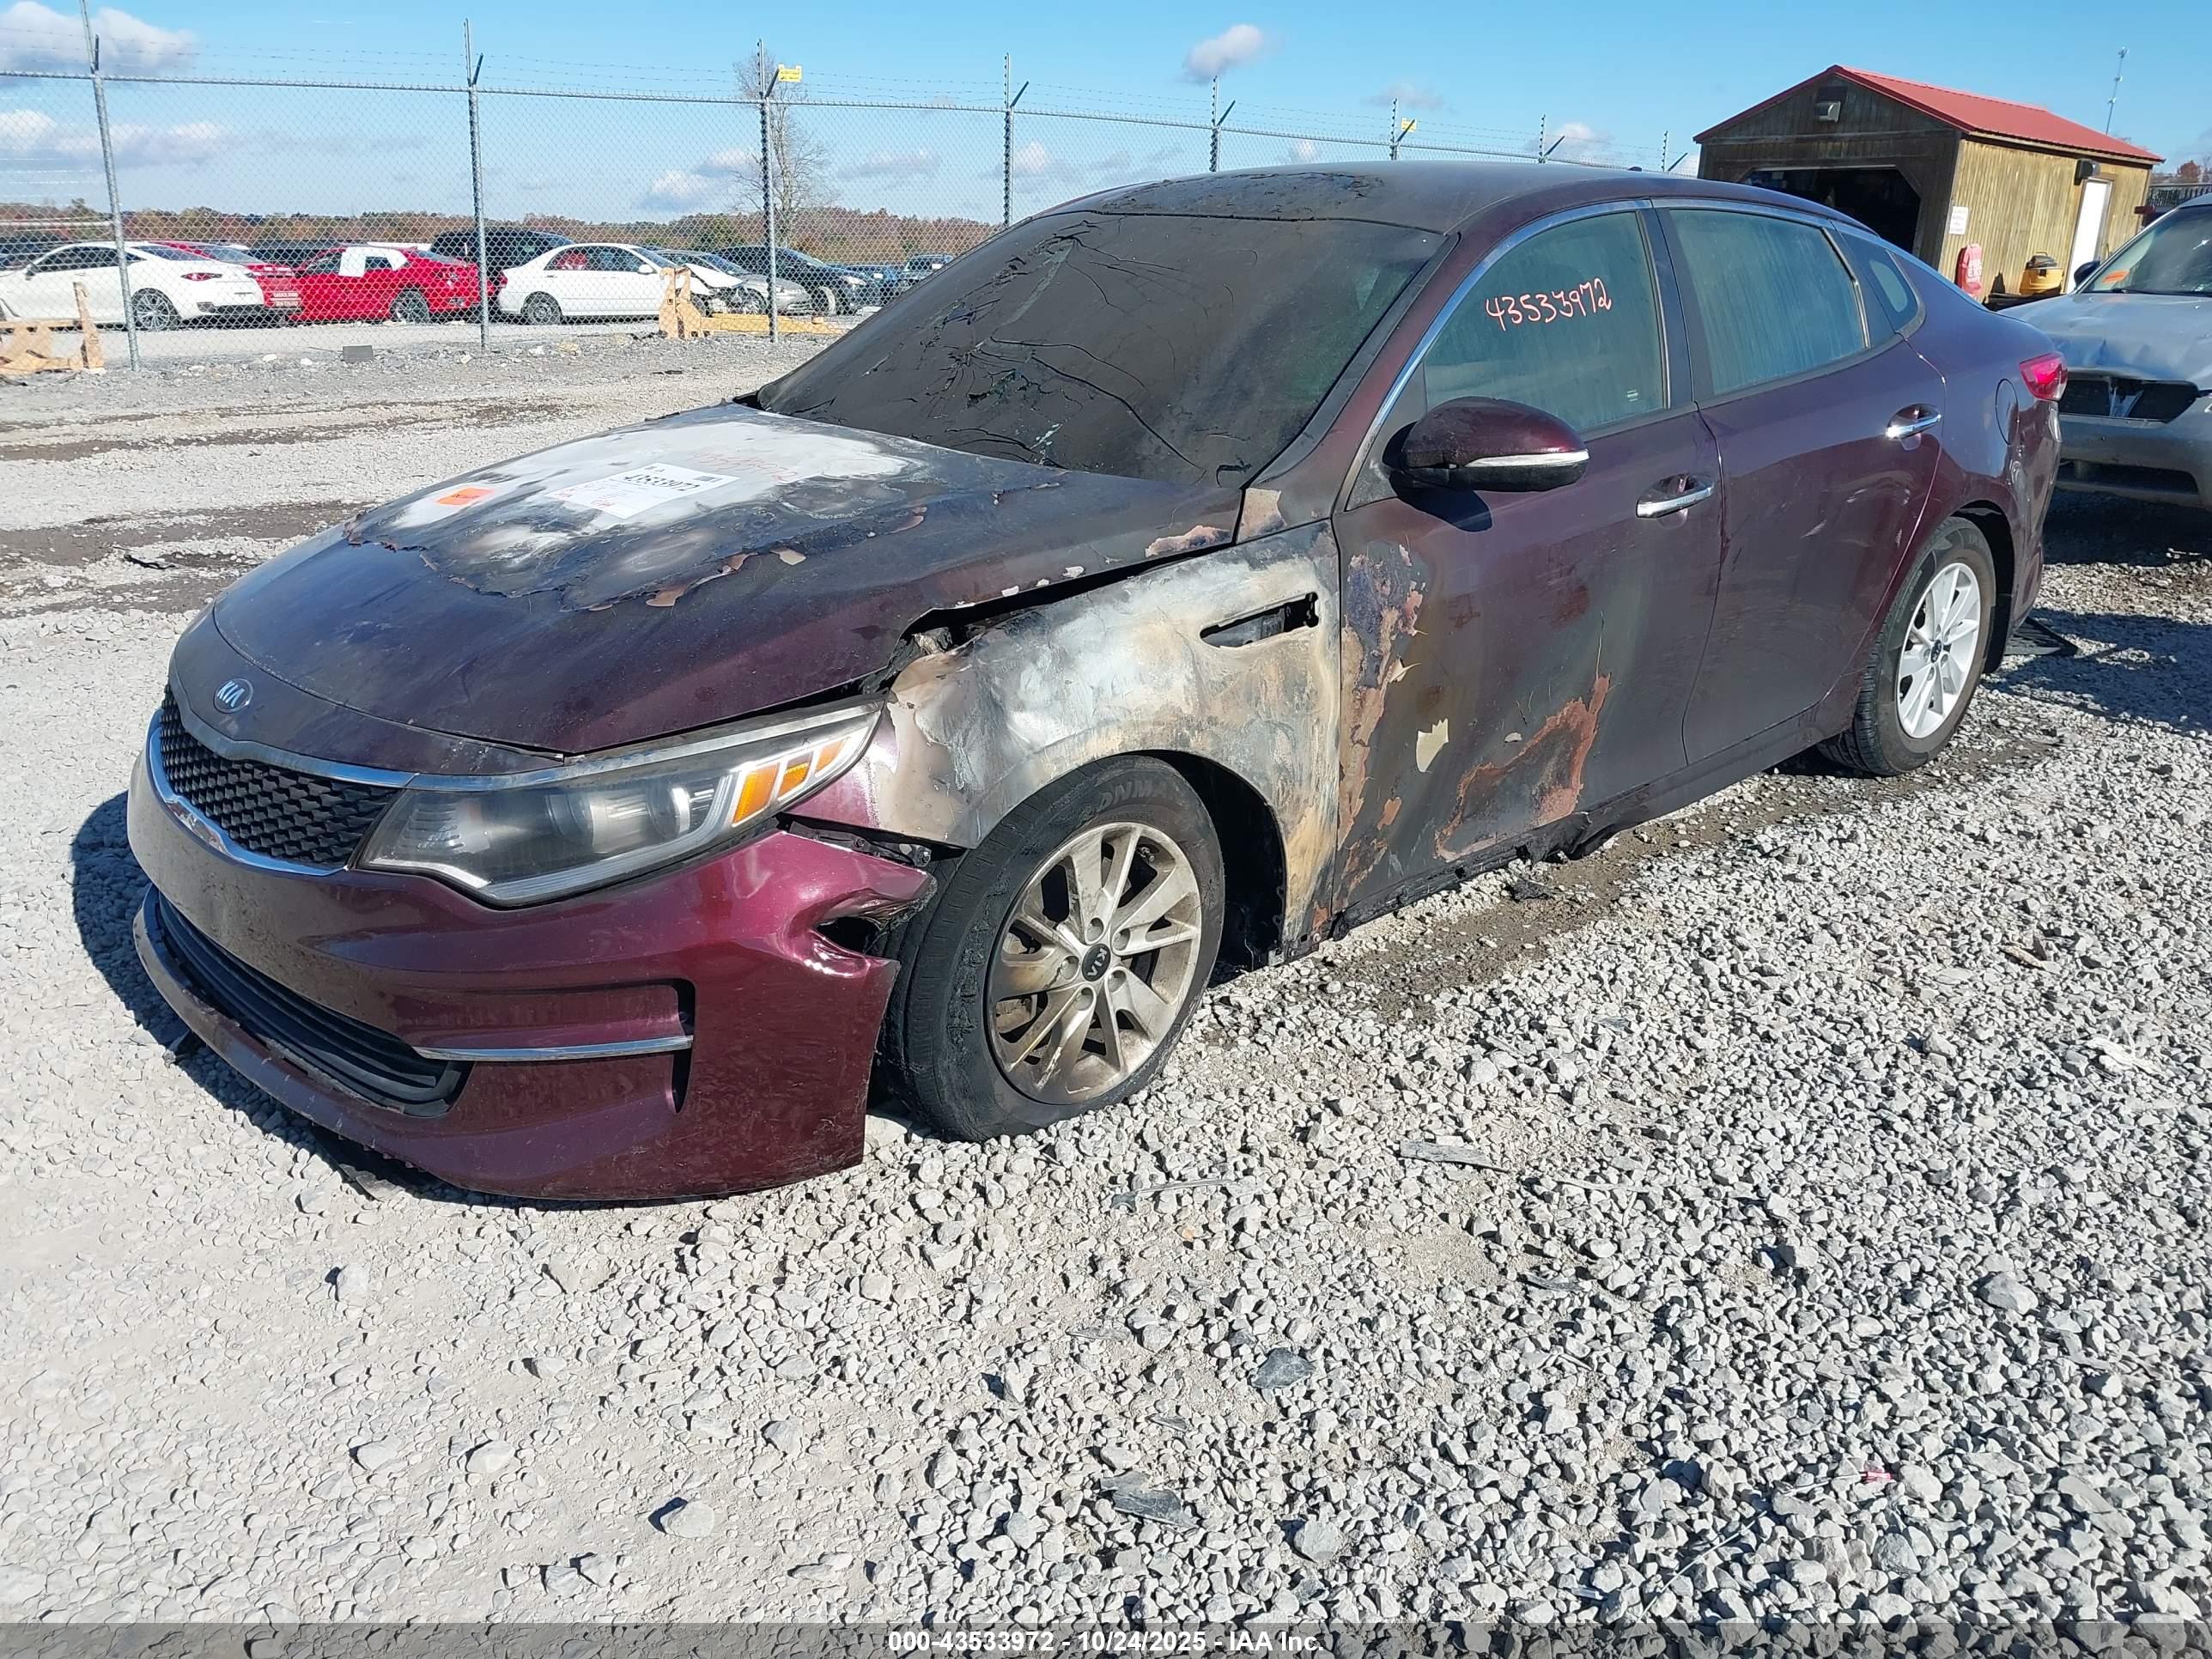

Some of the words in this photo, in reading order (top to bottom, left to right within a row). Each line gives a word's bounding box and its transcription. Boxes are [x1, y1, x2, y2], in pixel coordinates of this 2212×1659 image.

[1486, 277, 1613, 331] 43533972
[216, 680, 246, 708] KIA
[1087, 947, 1108, 976] KIA
